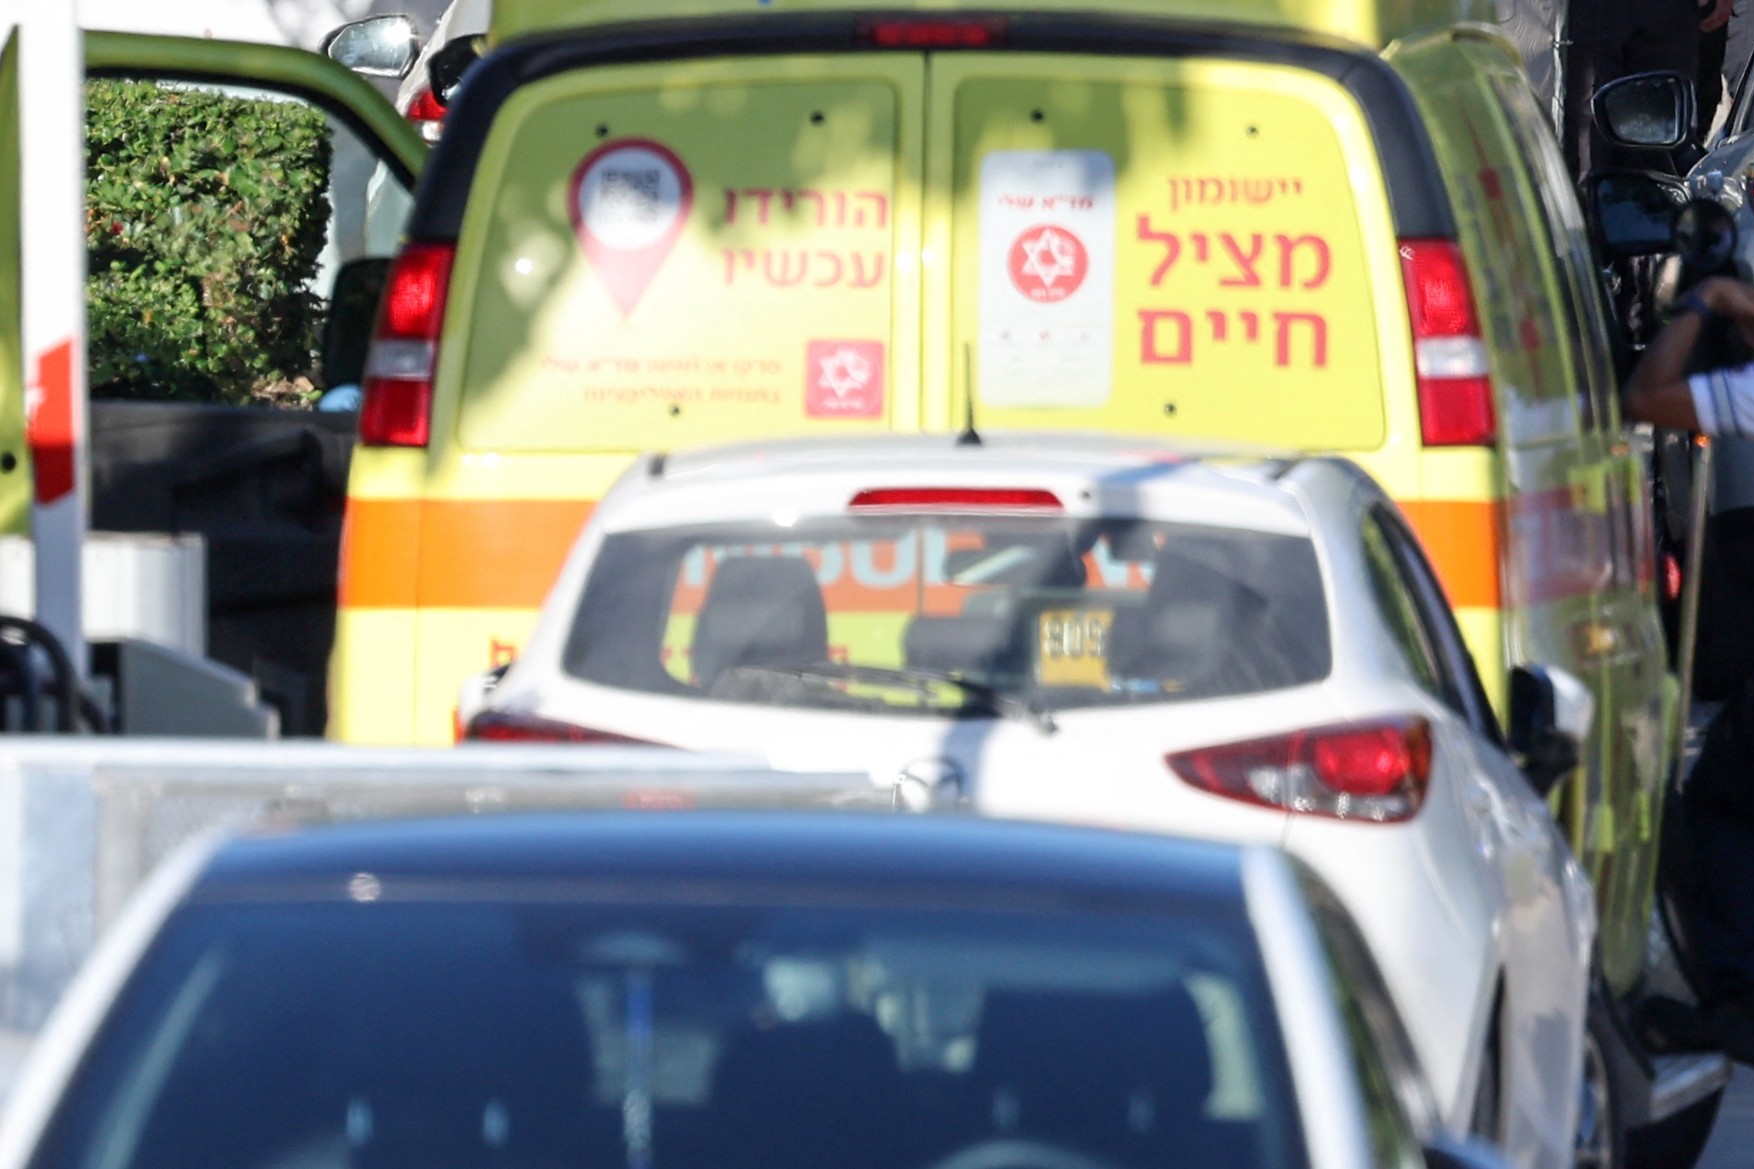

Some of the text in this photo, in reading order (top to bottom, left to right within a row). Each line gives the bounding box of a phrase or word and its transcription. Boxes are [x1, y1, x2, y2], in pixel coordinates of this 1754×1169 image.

[723, 187, 890, 229] הורידו
[1168, 177, 1304, 211] יישומון
[722, 247, 886, 289] עכשיו
[1136, 214, 1332, 289] מציל
[1137, 309, 1328, 369] חיים
